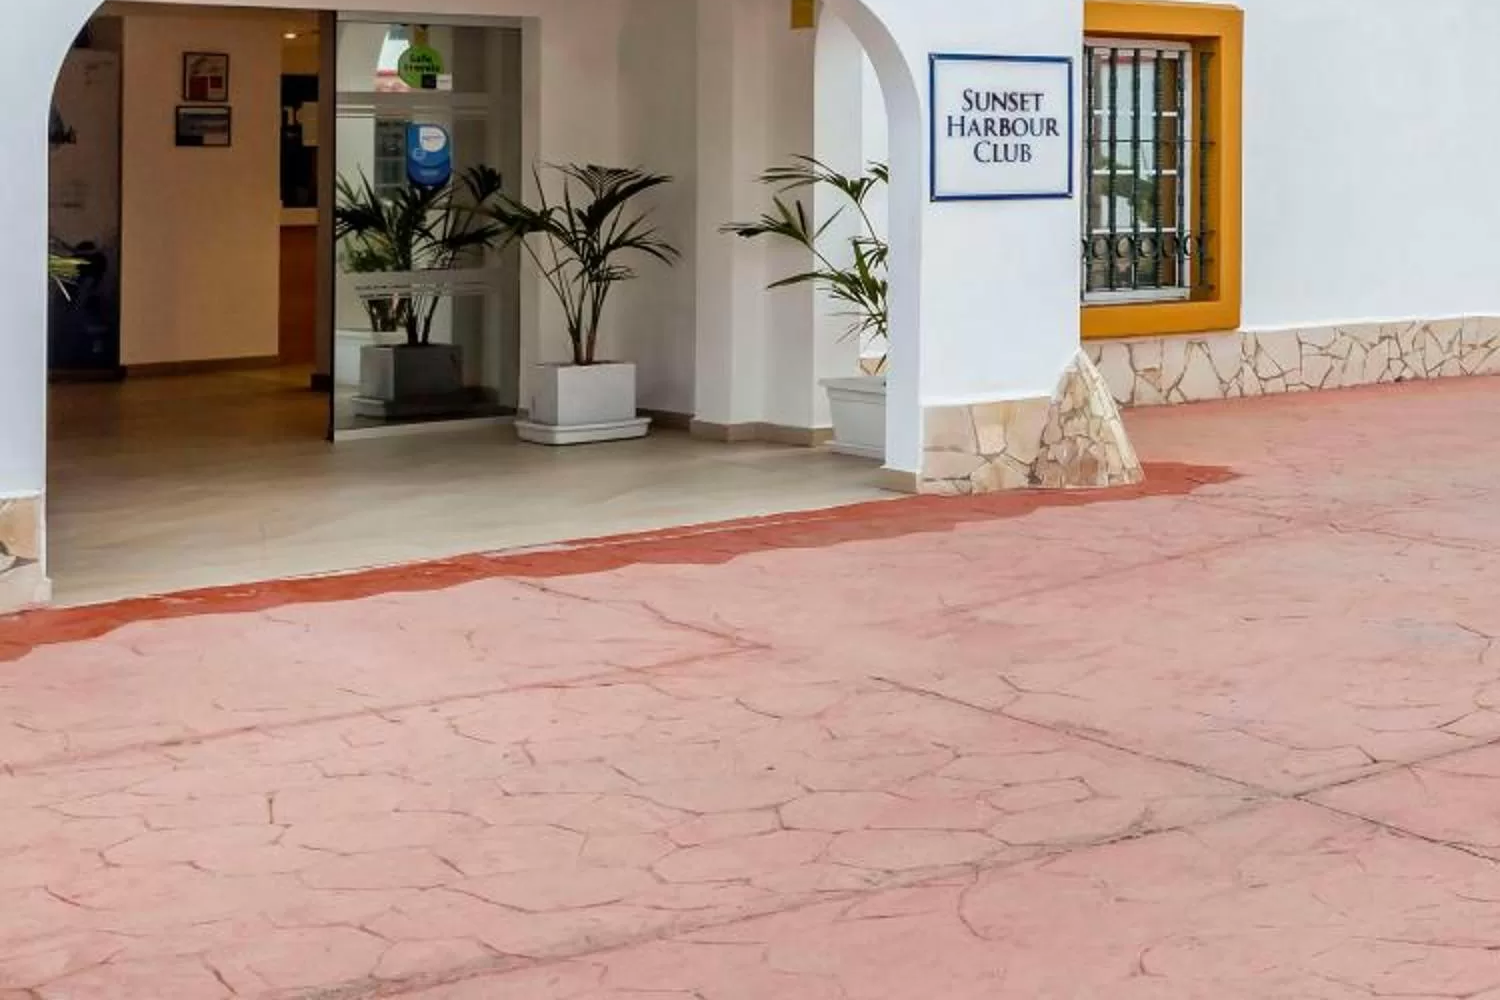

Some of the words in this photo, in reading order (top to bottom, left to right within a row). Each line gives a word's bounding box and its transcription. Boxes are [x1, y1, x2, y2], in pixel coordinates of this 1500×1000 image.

[962, 88, 1044, 112] SUNSET
[947, 115, 1060, 137] HARBOUR
[973, 140, 1032, 163] CLUB
